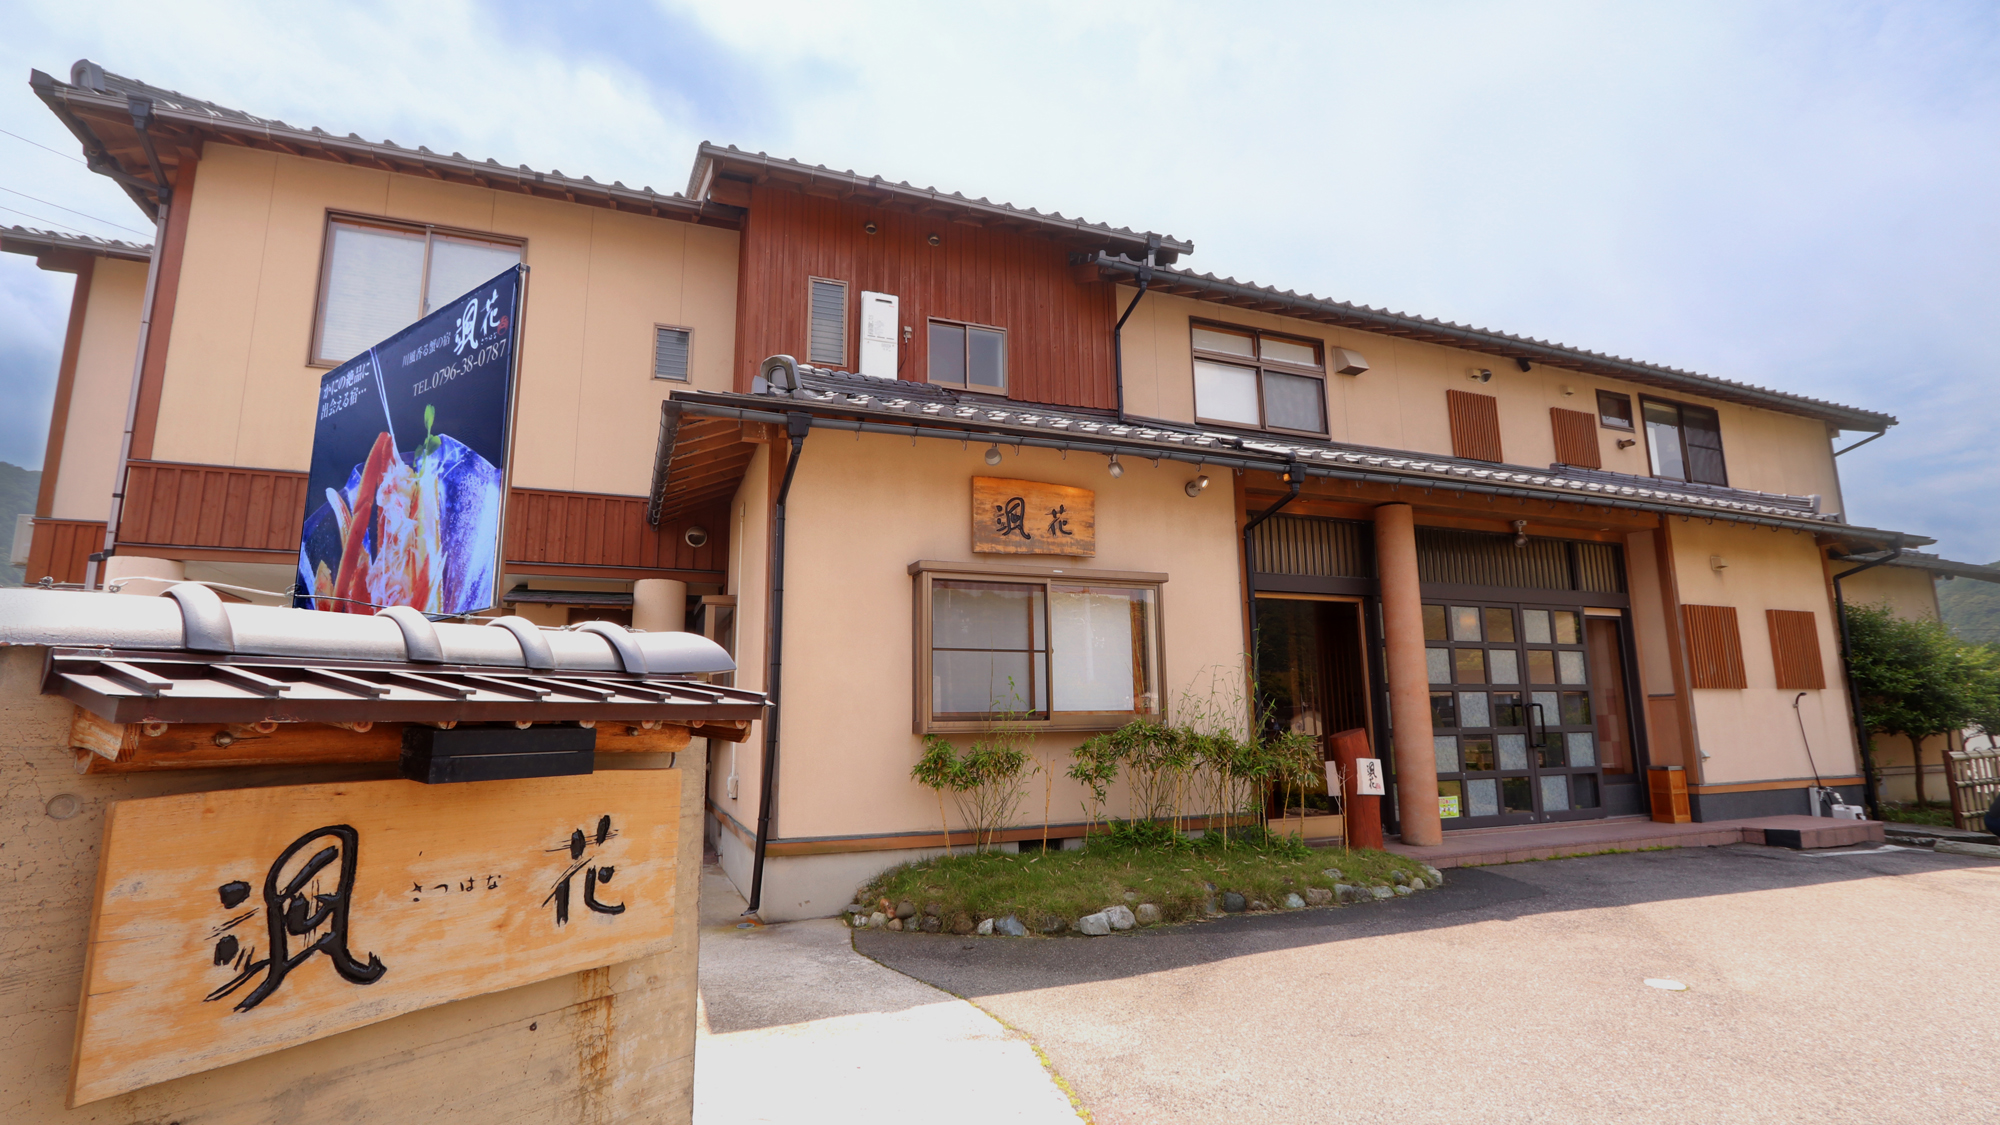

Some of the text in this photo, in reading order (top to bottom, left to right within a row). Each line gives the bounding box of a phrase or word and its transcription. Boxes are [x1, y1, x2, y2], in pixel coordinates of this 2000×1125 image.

[322, 361, 371, 399] かにの絶品に
